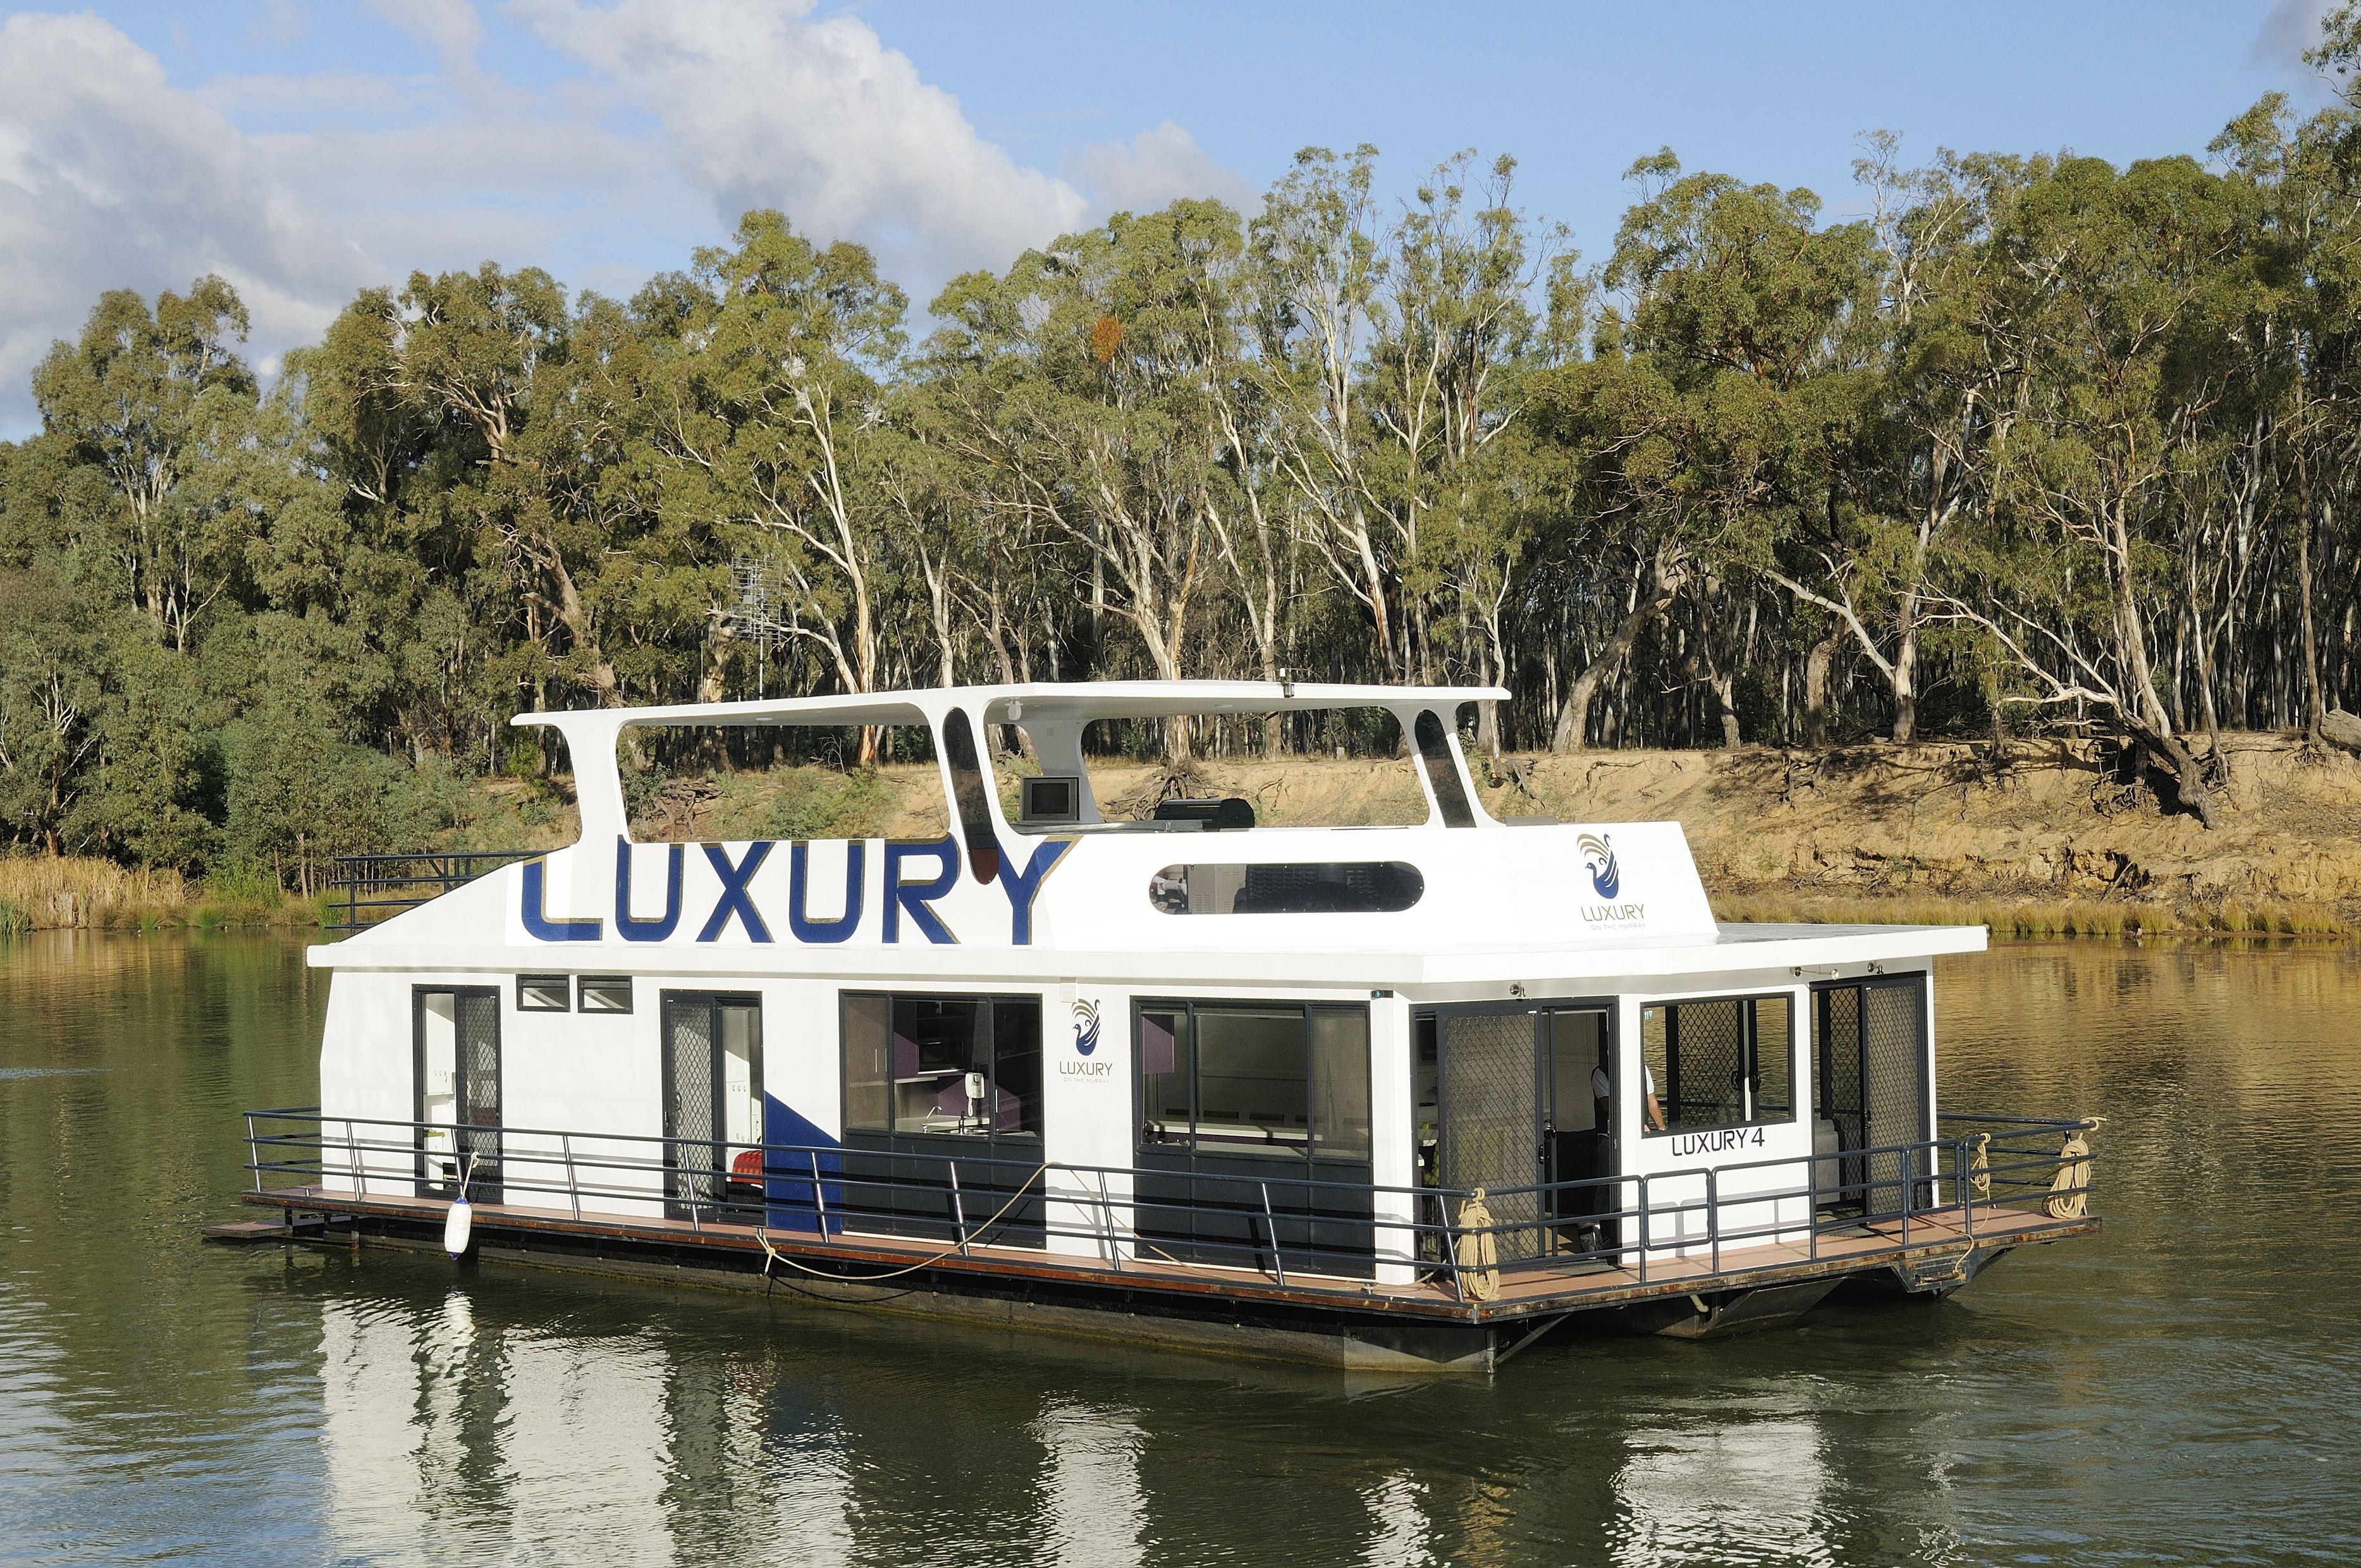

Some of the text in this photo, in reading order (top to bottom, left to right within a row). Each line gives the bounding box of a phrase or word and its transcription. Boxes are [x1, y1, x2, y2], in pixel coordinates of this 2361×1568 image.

[521, 833, 1083, 945] LUXURY
[1581, 904, 1644, 921] LUXURY
[1060, 1061, 1112, 1076] LUXURY
[1672, 1127, 1765, 1156] LUXURY 4
